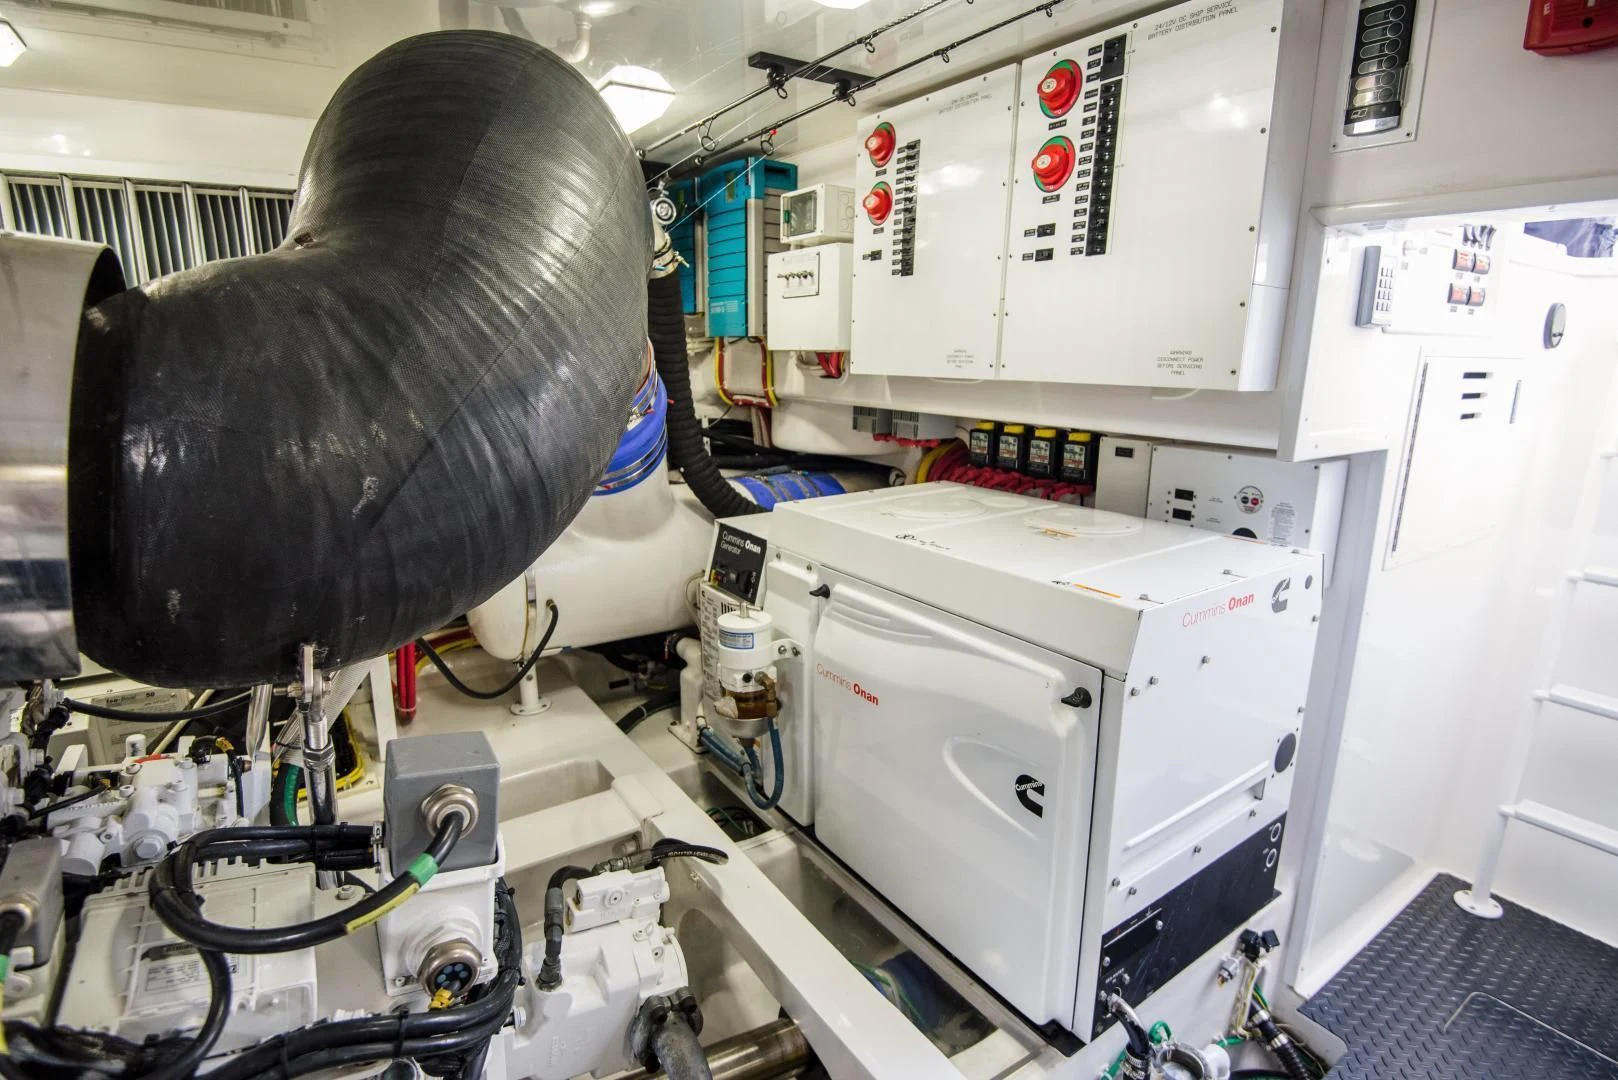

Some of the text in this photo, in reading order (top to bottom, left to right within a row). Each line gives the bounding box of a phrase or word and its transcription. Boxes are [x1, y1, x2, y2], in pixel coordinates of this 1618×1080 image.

[1148, 6, 1238, 40] BATTERY DISTRIBUTION PANEL
[1189, 9, 1204, 20] SHIP
[1206, 0, 1233, 14] SERVICE
[720, 540, 742, 556] Generator
[722, 530, 762, 555] Cummins Onan
[1182, 593, 1255, 628] Cummins Onan
[816, 663, 879, 706] Cummins Onan
